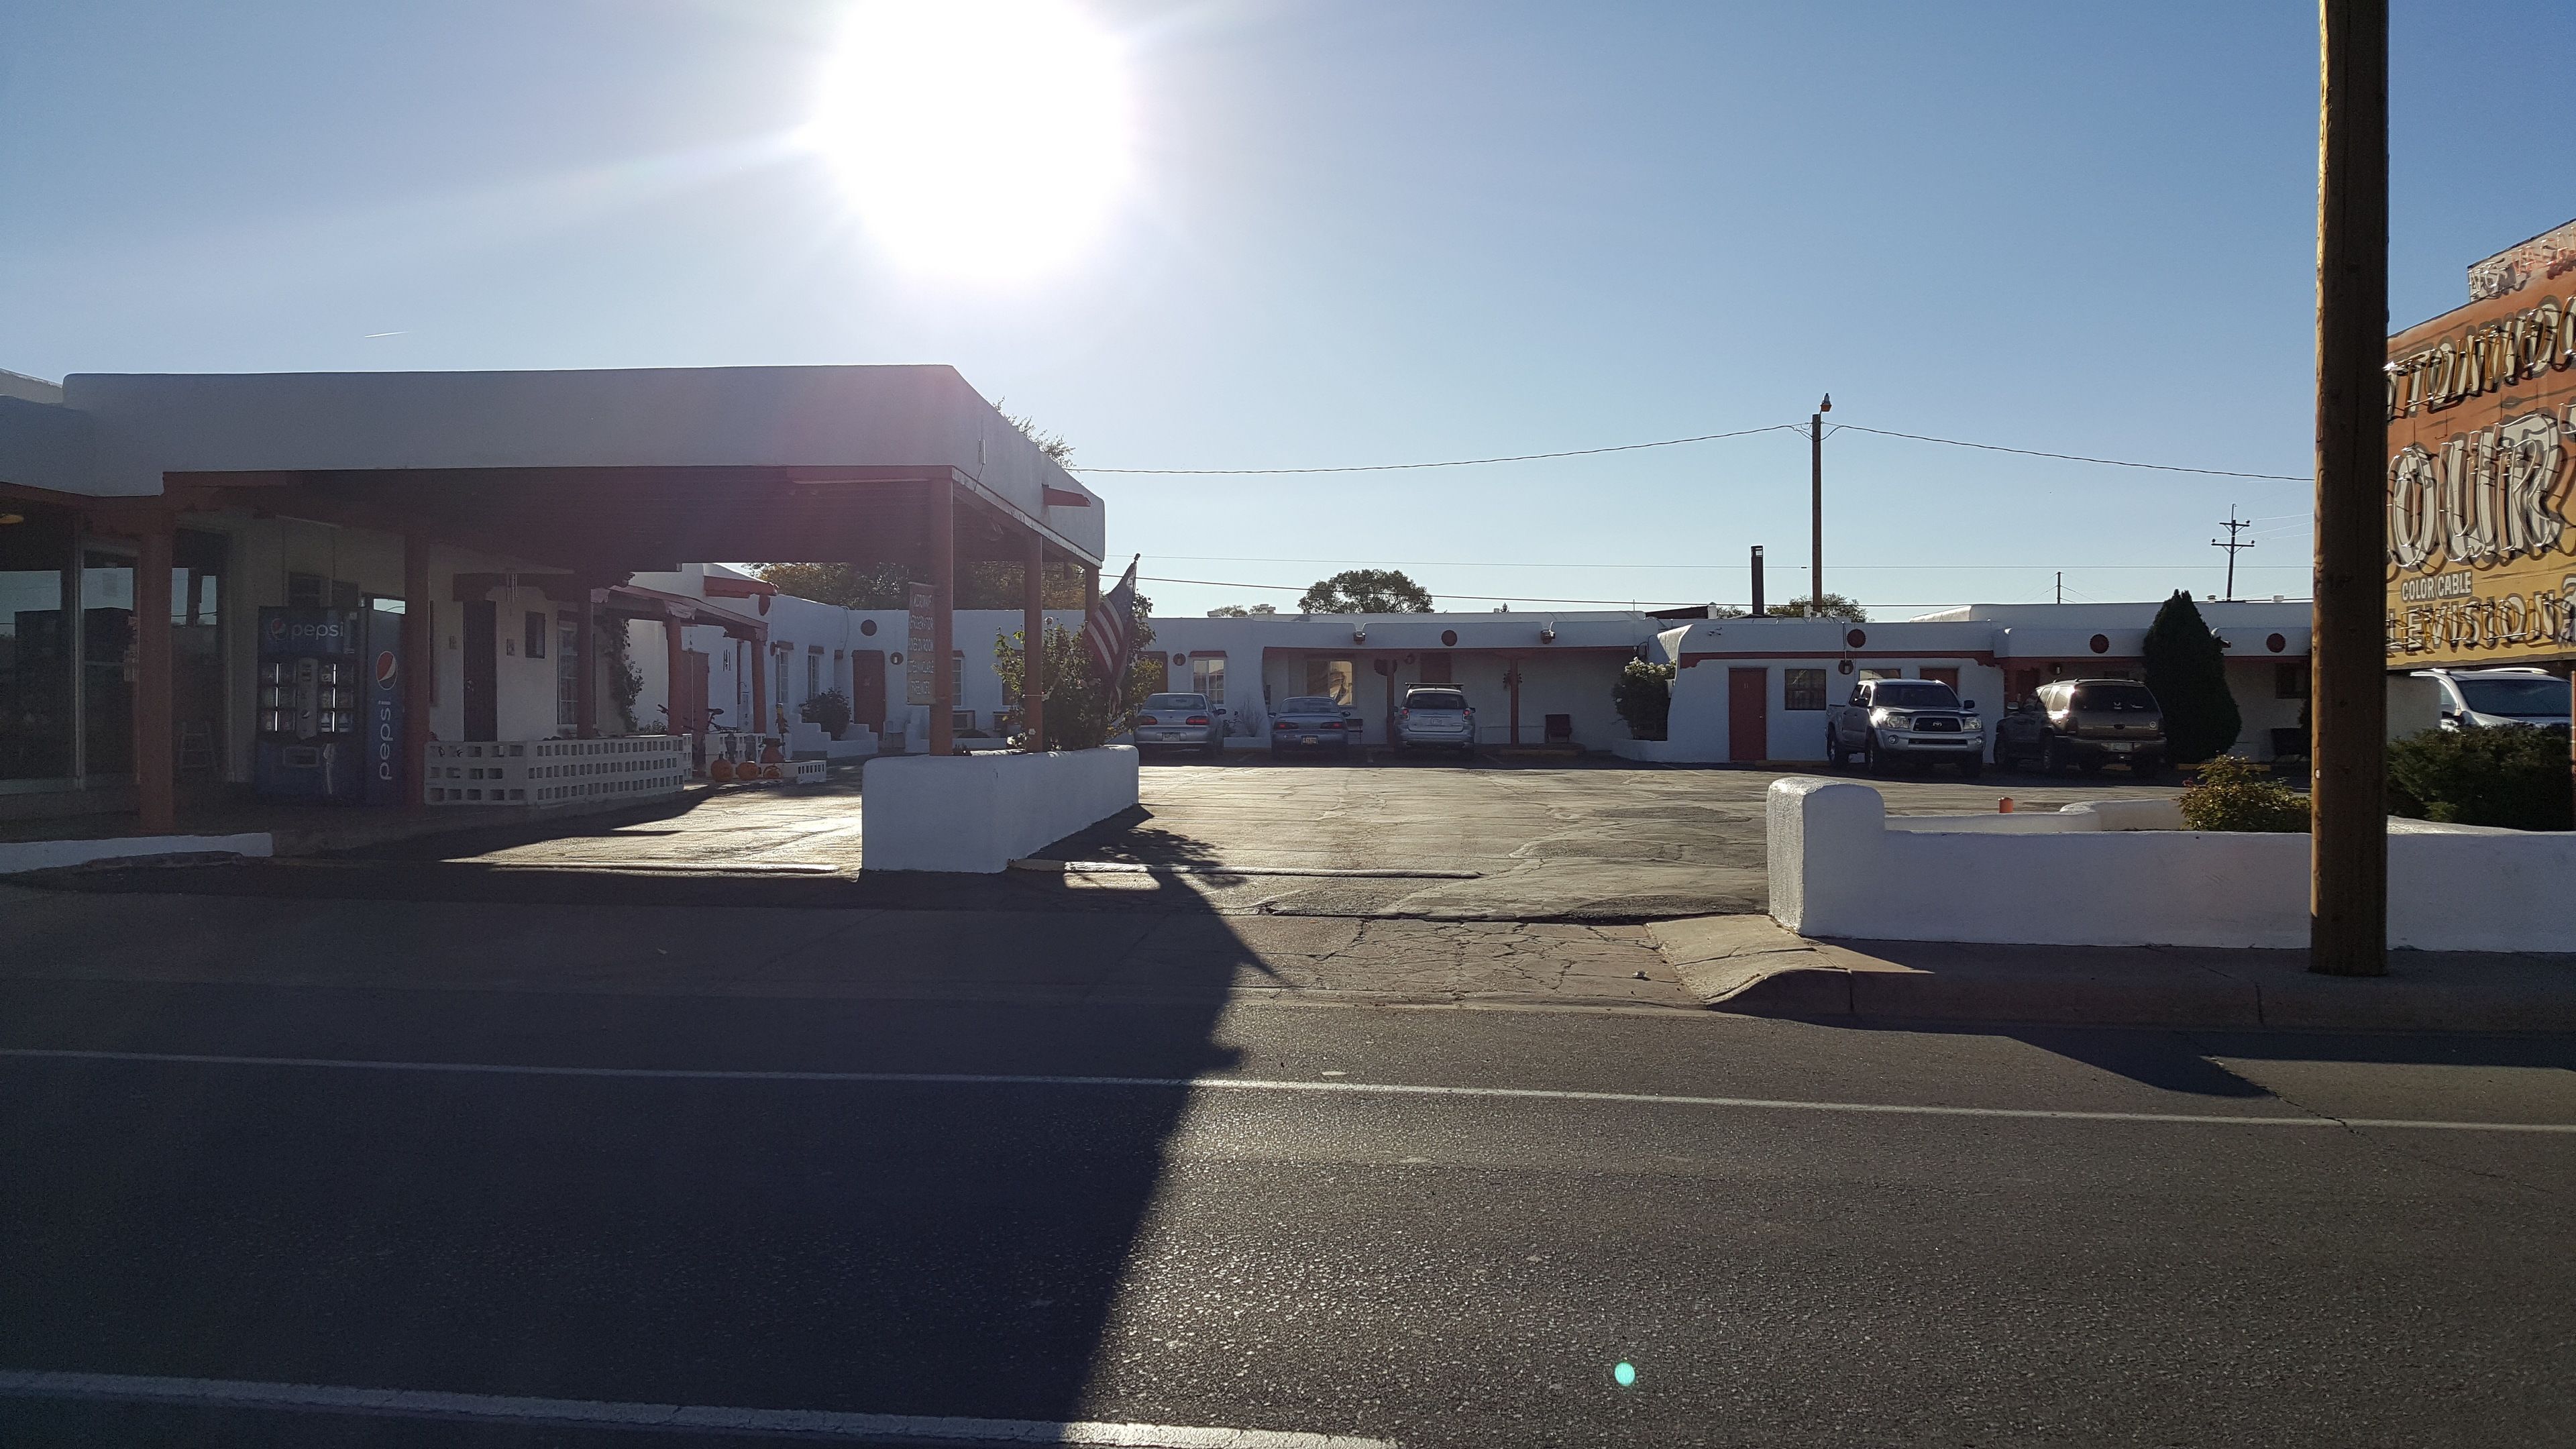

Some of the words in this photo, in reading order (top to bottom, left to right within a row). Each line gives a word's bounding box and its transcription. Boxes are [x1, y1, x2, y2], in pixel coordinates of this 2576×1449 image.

[2402, 579, 2434, 601] COLOR
[2437, 572, 2472, 598] CABLE
[291, 622, 344, 640] pepsi
[378, 700, 393, 780] pepsi
